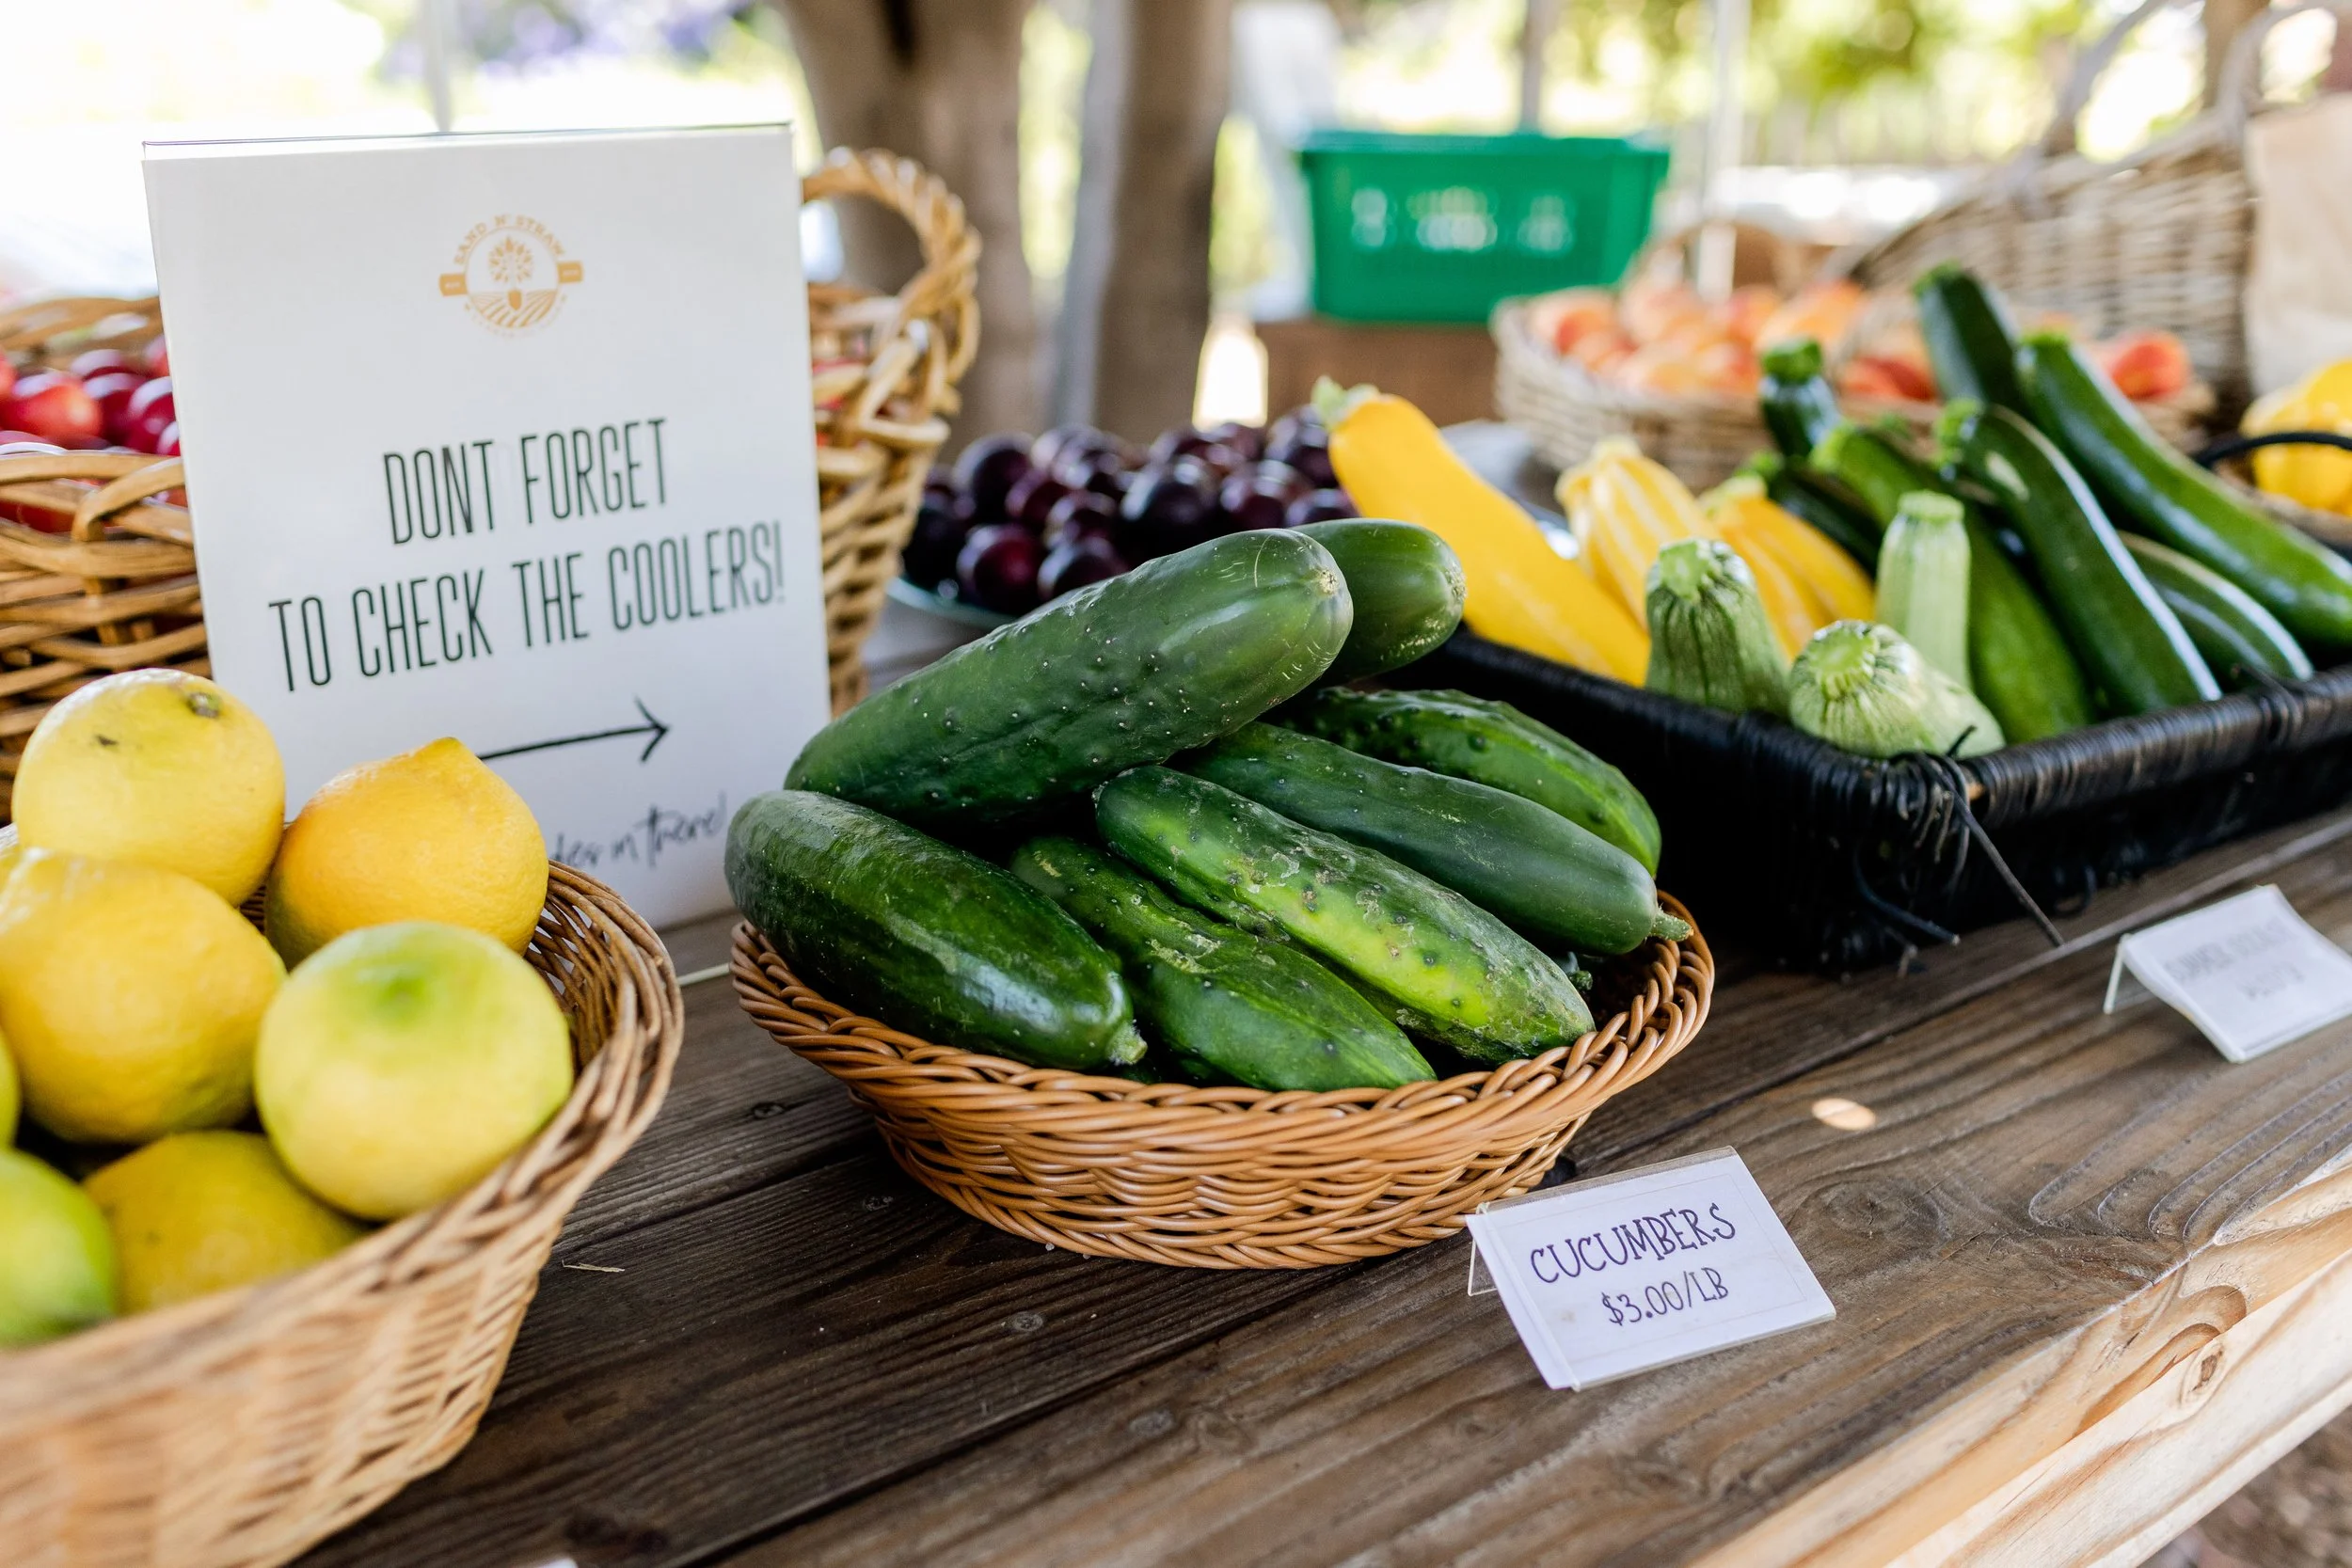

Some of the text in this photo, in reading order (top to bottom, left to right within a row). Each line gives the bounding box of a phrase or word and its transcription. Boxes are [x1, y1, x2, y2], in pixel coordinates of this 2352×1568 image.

[453, 221, 487, 265] SAND
[516, 214, 565, 257] STRAW
[382, 417, 668, 546] DONT FORGET
[268, 520, 787, 693] TO CHECK THE COOLERS!
[1529, 1201, 1737, 1285] CUCUMBERS
[1600, 1266, 1729, 1327] $3.00/LB
